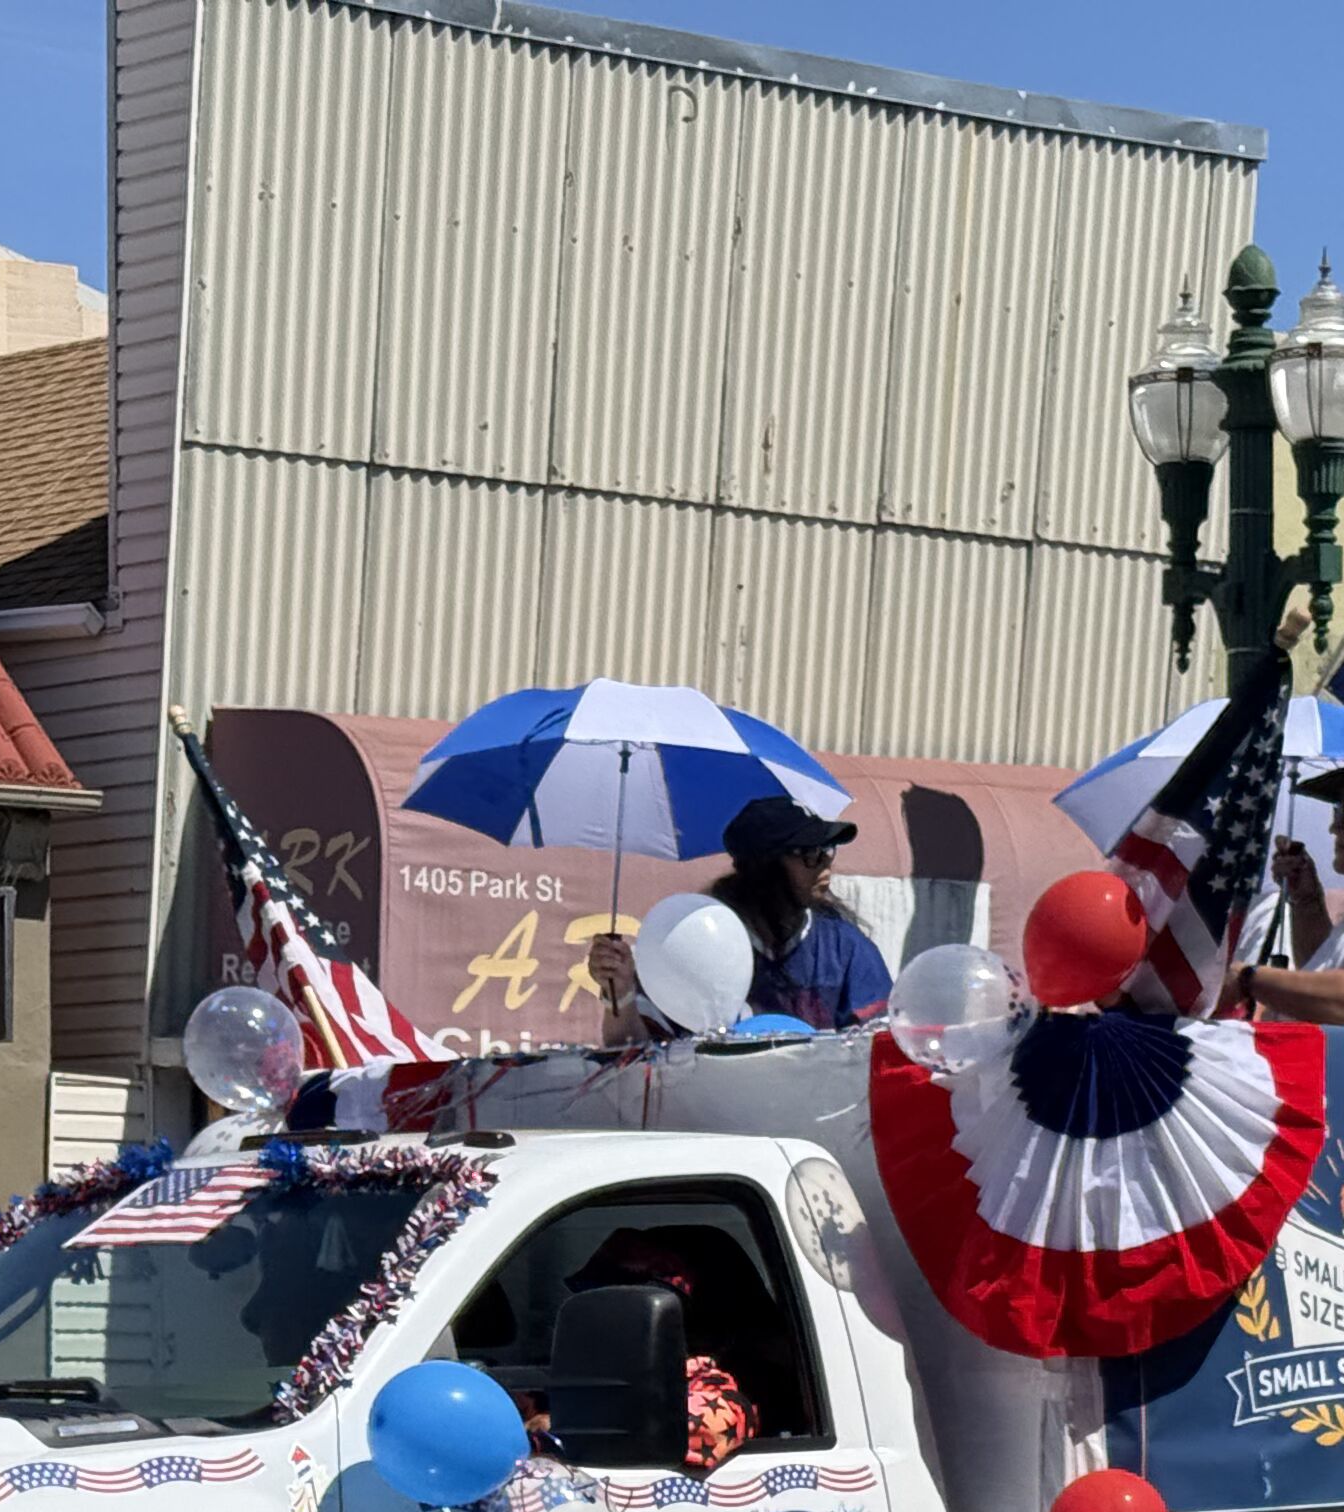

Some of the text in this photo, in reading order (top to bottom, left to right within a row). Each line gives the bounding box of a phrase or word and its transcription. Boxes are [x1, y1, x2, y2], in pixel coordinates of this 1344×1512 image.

[268, 827, 371, 902] RK
[399, 866, 564, 902] 1405 Park St
[1259, 1360, 1334, 1397] SMALL
